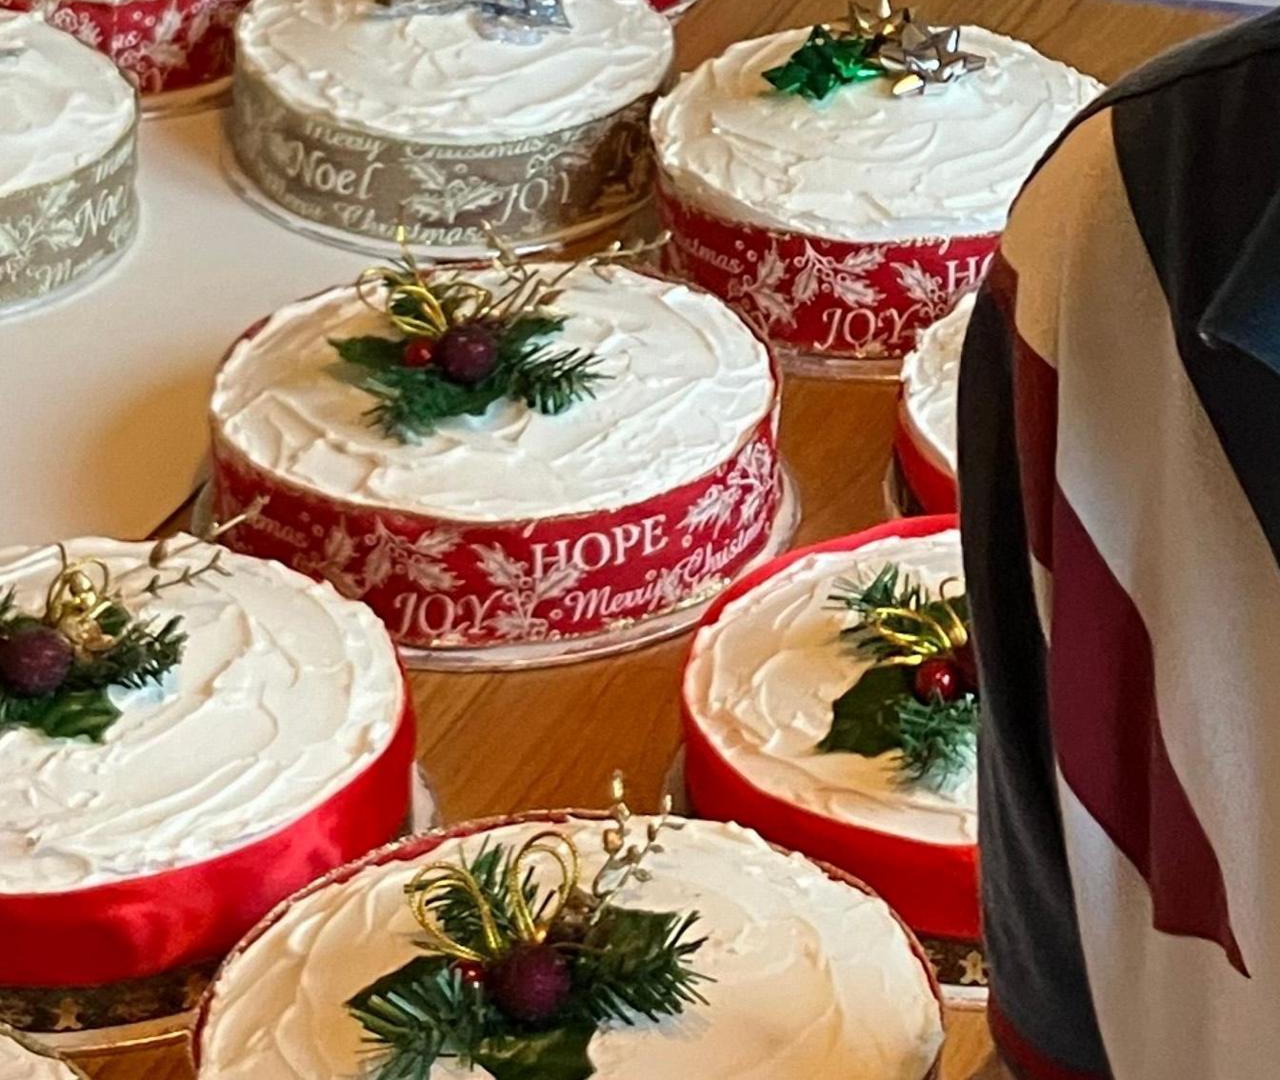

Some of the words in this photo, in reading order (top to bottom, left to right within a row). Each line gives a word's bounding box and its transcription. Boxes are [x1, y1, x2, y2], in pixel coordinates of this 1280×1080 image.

[286, 139, 384, 200] Noel
[814, 303, 924, 351] JOY
[530, 513, 669, 578] HOPE
[392, 588, 508, 639] JOY
[563, 578, 668, 622] Merry
